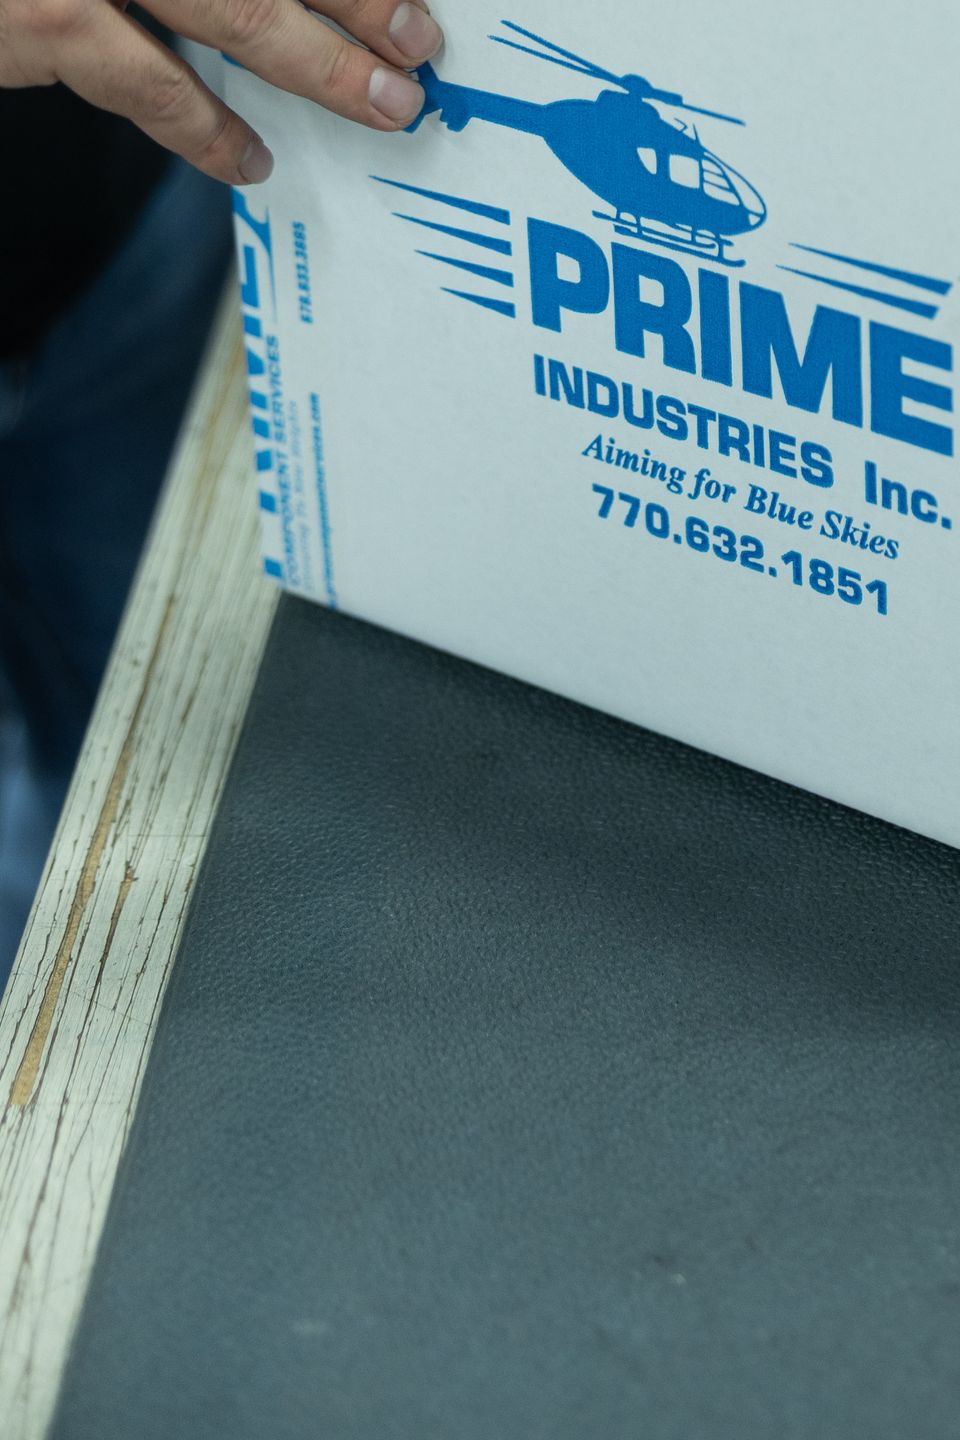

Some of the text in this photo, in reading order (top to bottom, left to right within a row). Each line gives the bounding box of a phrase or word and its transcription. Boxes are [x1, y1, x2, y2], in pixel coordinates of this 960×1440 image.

[527, 216, 954, 457] PRIME
[533, 353, 953, 530] INDUSTRIES Inc.
[581, 433, 900, 561] Aiming for Blue Skies
[591, 482, 889, 616] 770.632.1851
